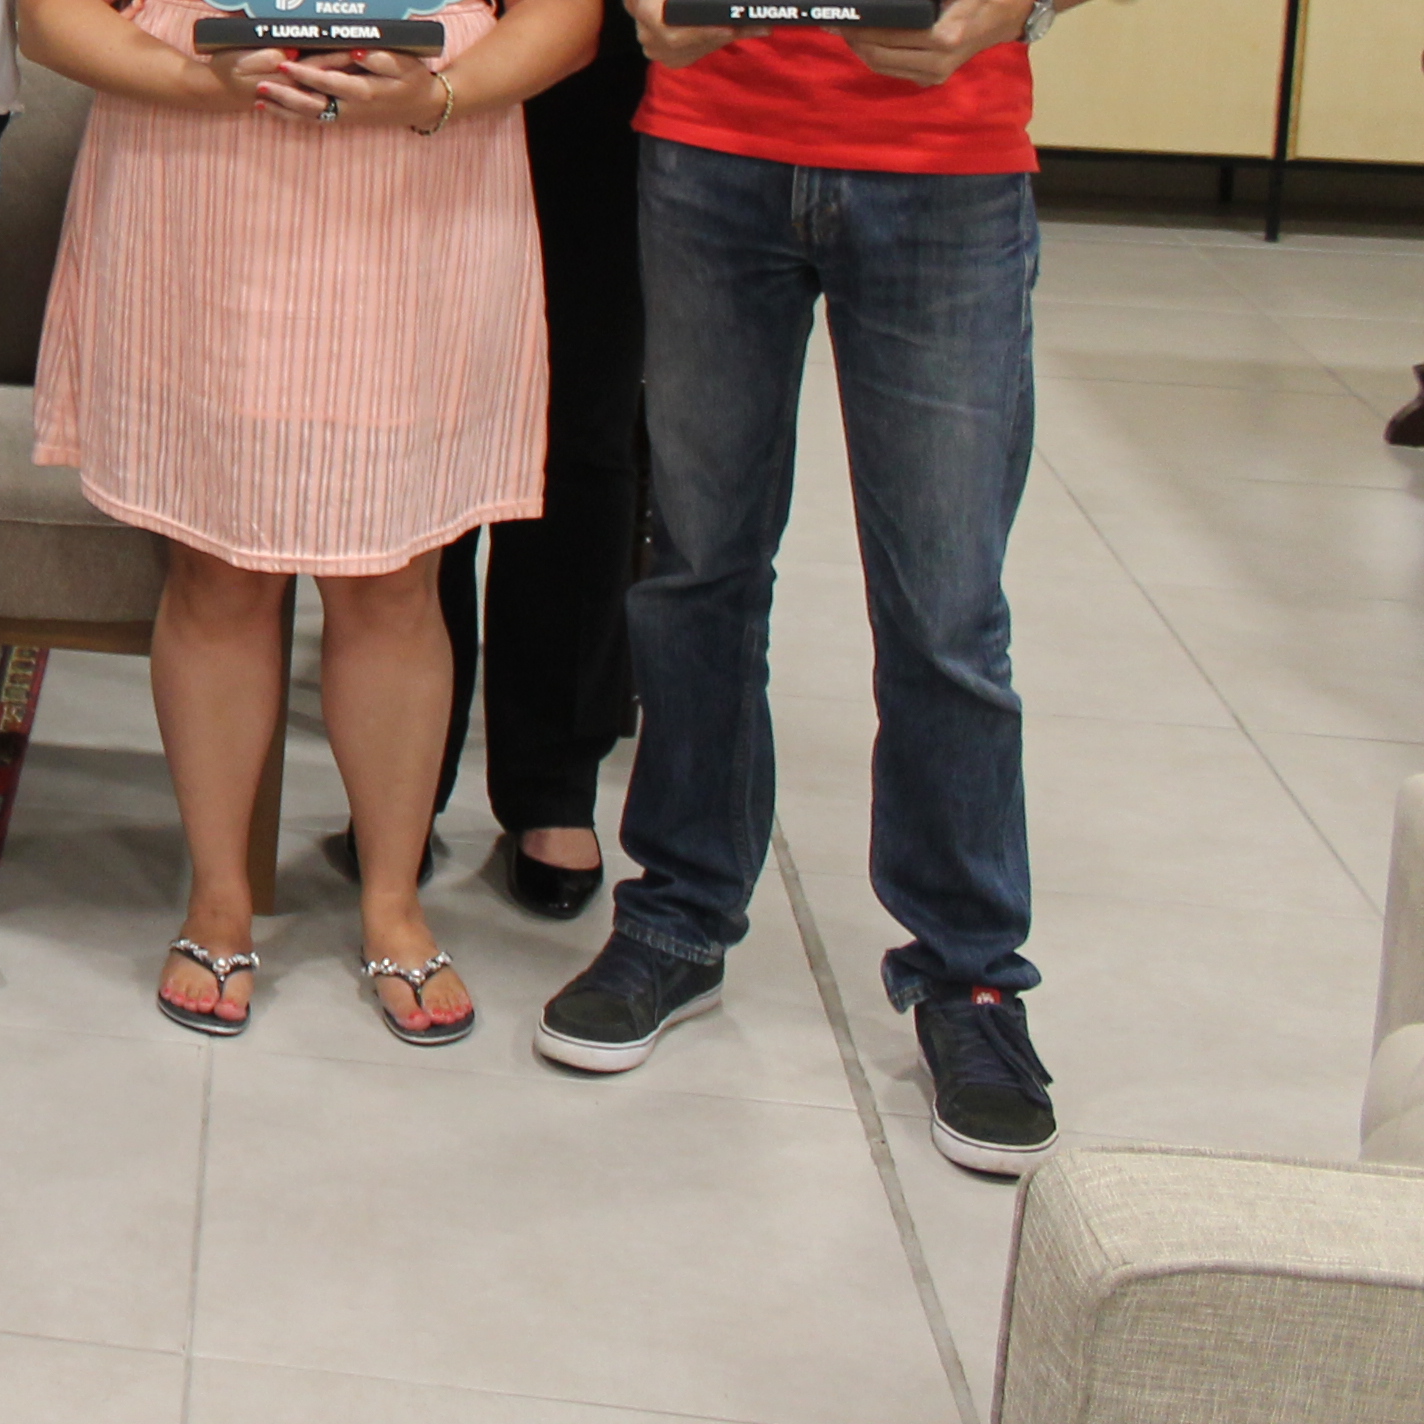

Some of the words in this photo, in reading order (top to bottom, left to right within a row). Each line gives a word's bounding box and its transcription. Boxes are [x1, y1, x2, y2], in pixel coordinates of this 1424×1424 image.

[315, 2, 365, 14] FACCAT
[749, 6, 798, 20] LUGAR
[811, 7, 860, 20] GERAL
[272, 26, 319, 38] LUGAR
[331, 26, 380, 39] POEMA
